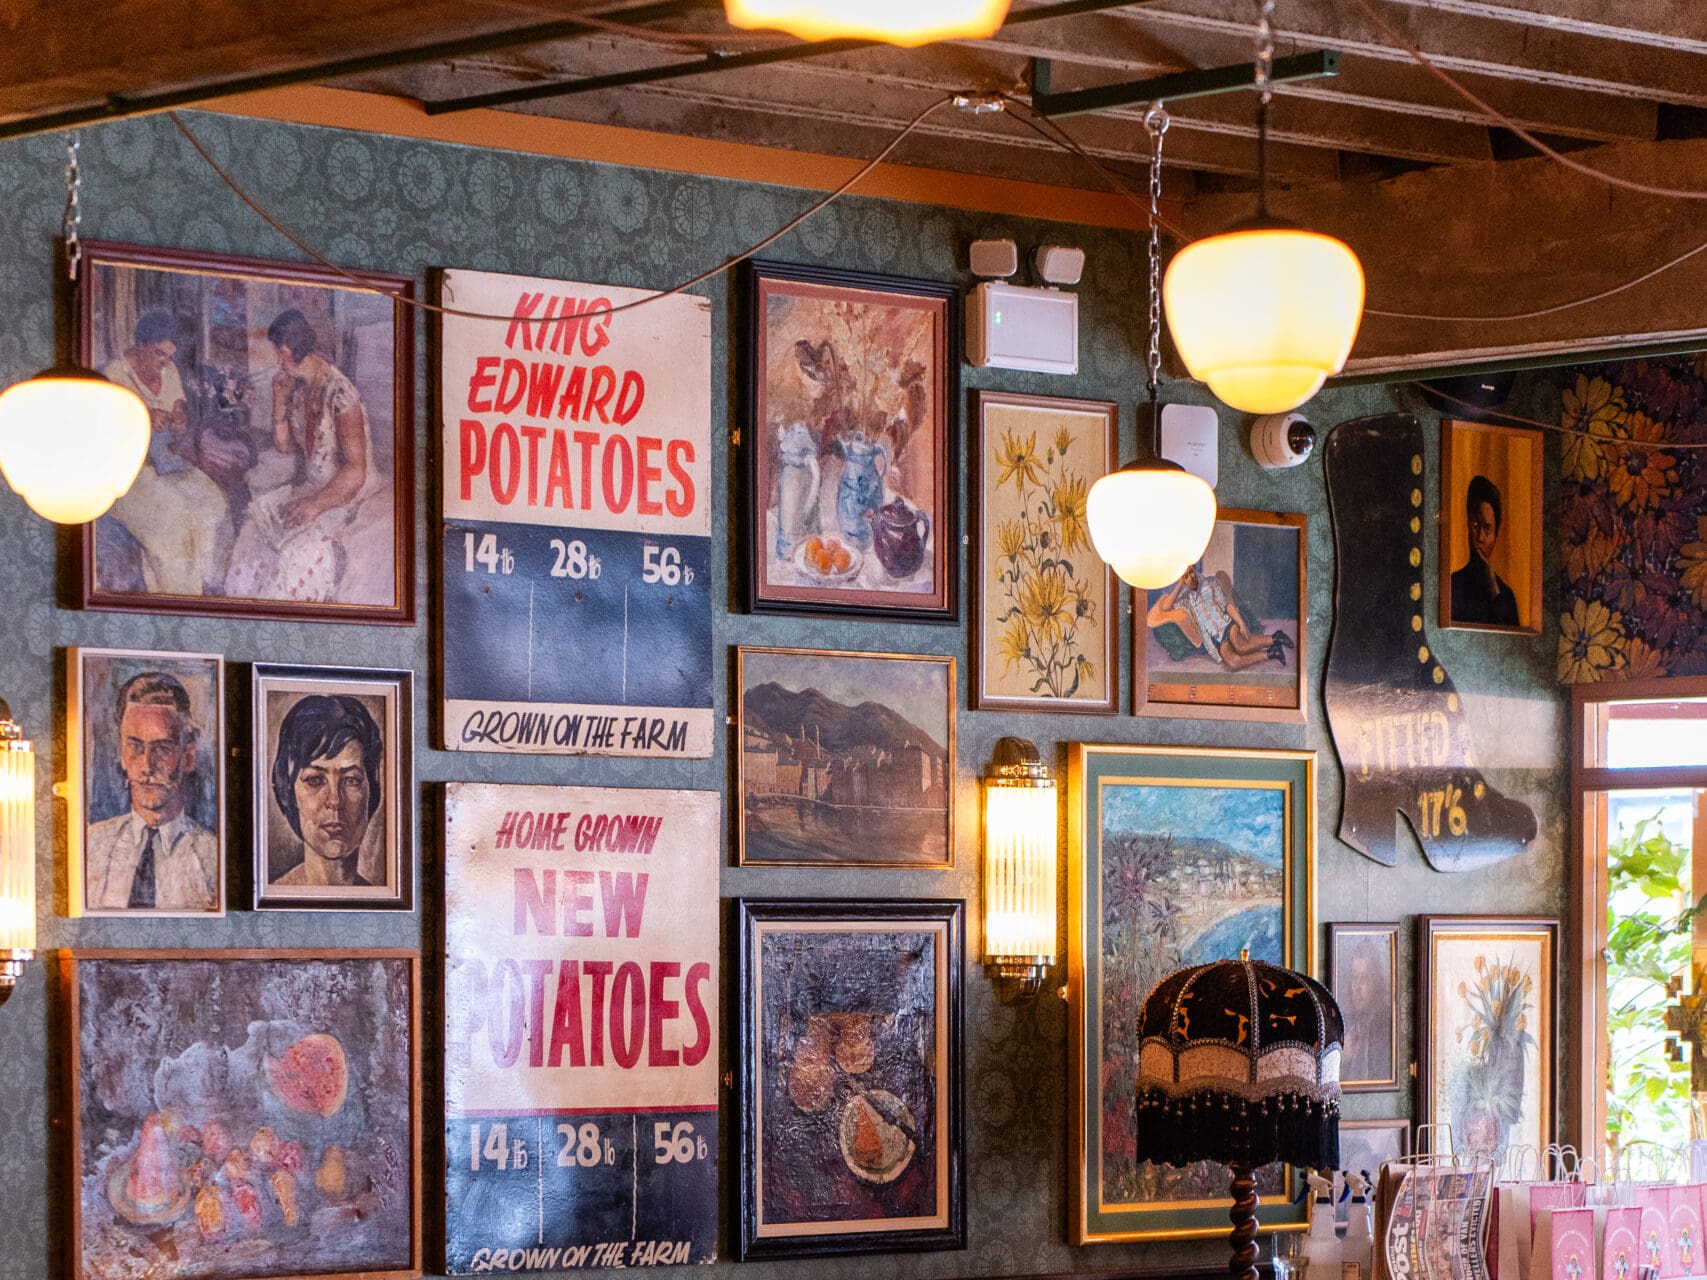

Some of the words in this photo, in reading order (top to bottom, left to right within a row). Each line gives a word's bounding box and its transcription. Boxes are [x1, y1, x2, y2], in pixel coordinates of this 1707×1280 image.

[505, 292, 613, 357] KING
[467, 356, 645, 427] EDWARD
[459, 419, 696, 518] POTATOES
[462, 710, 553, 746] GROWN
[553, 714, 585, 746] ON
[584, 715, 618, 748] THE
[620, 717, 690, 752] FARM
[495, 811, 571, 852] HOME
[574, 813, 663, 855] GROWN
[513, 868, 649, 938] NEW
[456, 958, 711, 1070] POTATOES
[470, 1247, 559, 1272] GROWN
[562, 1246, 592, 1267] ON
[591, 1242, 626, 1269] THE
[631, 1240, 691, 1265] FARM
[1459, 1221, 1470, 1241] VAN
[1460, 1244, 1469, 1255] OF
